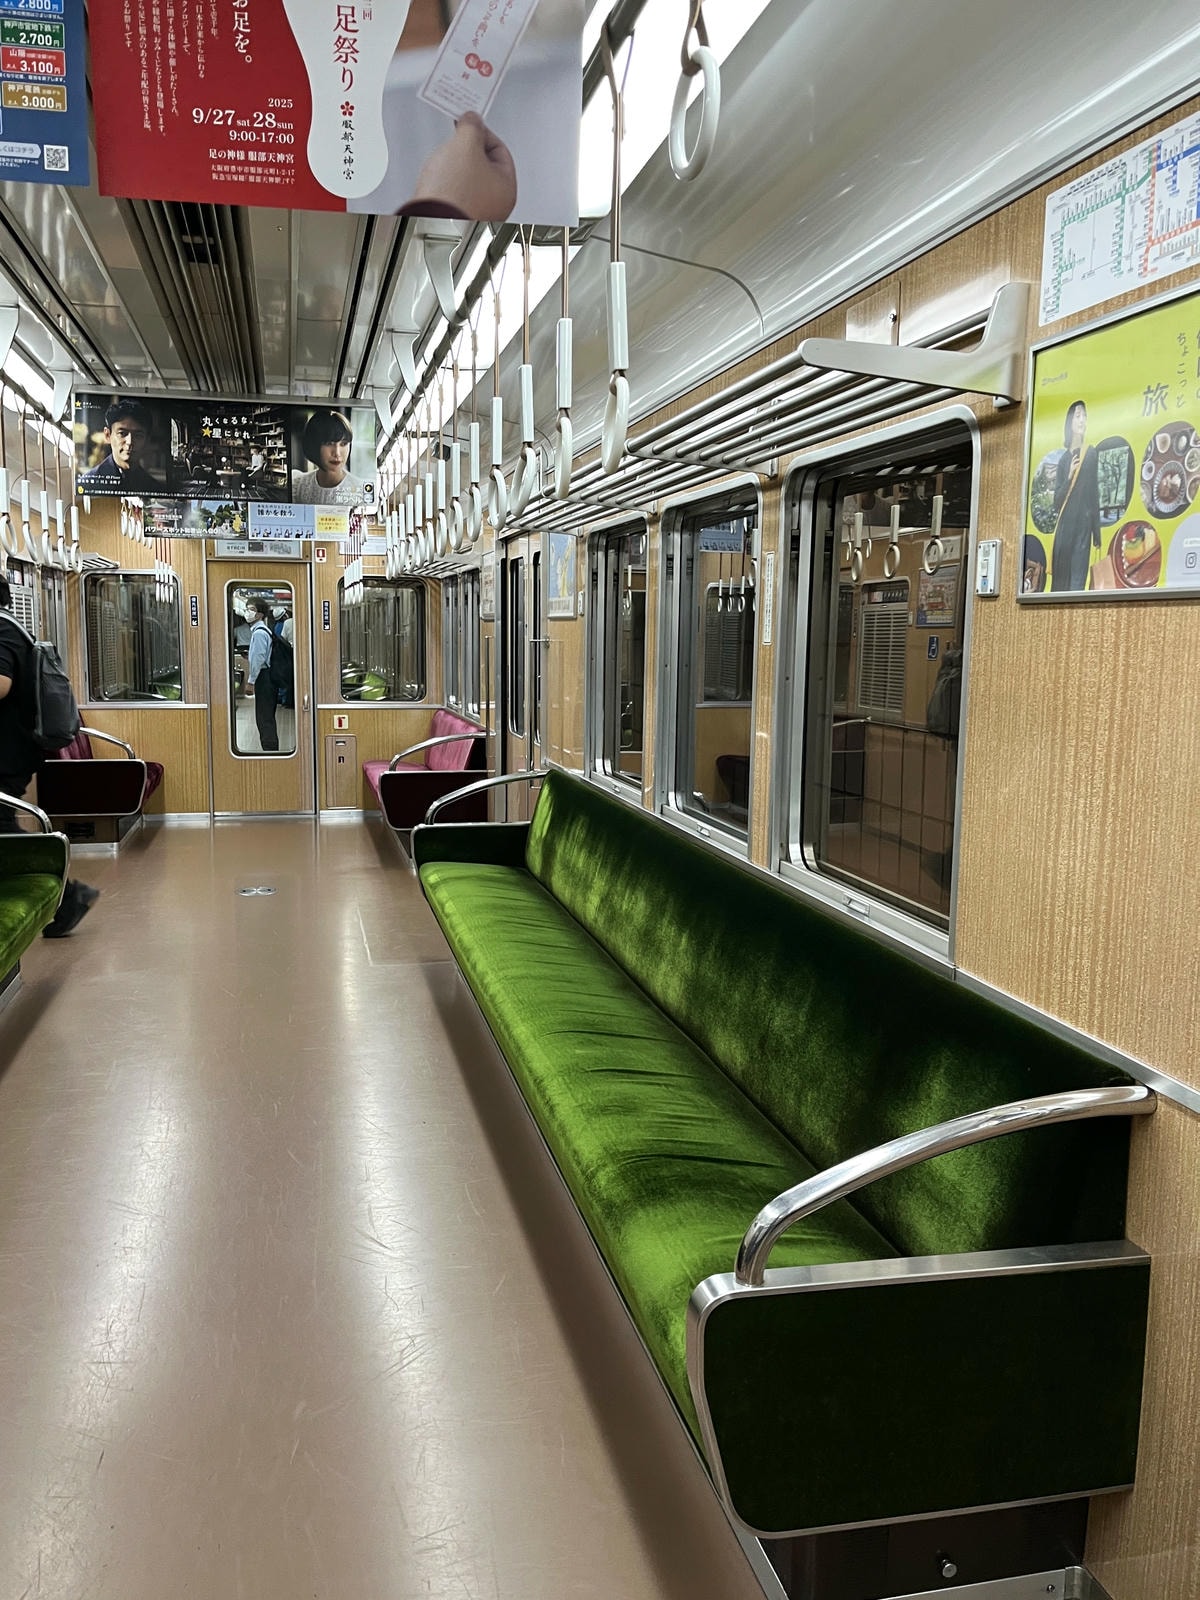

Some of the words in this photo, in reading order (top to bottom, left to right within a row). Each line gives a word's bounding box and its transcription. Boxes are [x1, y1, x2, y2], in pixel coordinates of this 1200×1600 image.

[333, 4, 360, 92] 足祭り
[267, 98, 294, 109] 2025
[191, 107, 236, 126] 9/27
[236, 119, 250, 127] sat
[253, 112, 277, 129] 28
[276, 122, 294, 130] sun
[229, 130, 295, 145] 9:00-17:00
[0, 145, 35, 154] くはコチラ
[209, 148, 246, 161] 足の神様
[248, 150, 295, 164] 服部天神宮
[341, 119, 355, 181] 服部天神宮
[1177, 332, 1190, 408] ちょこっと
[1142, 382, 1170, 417] 旅
